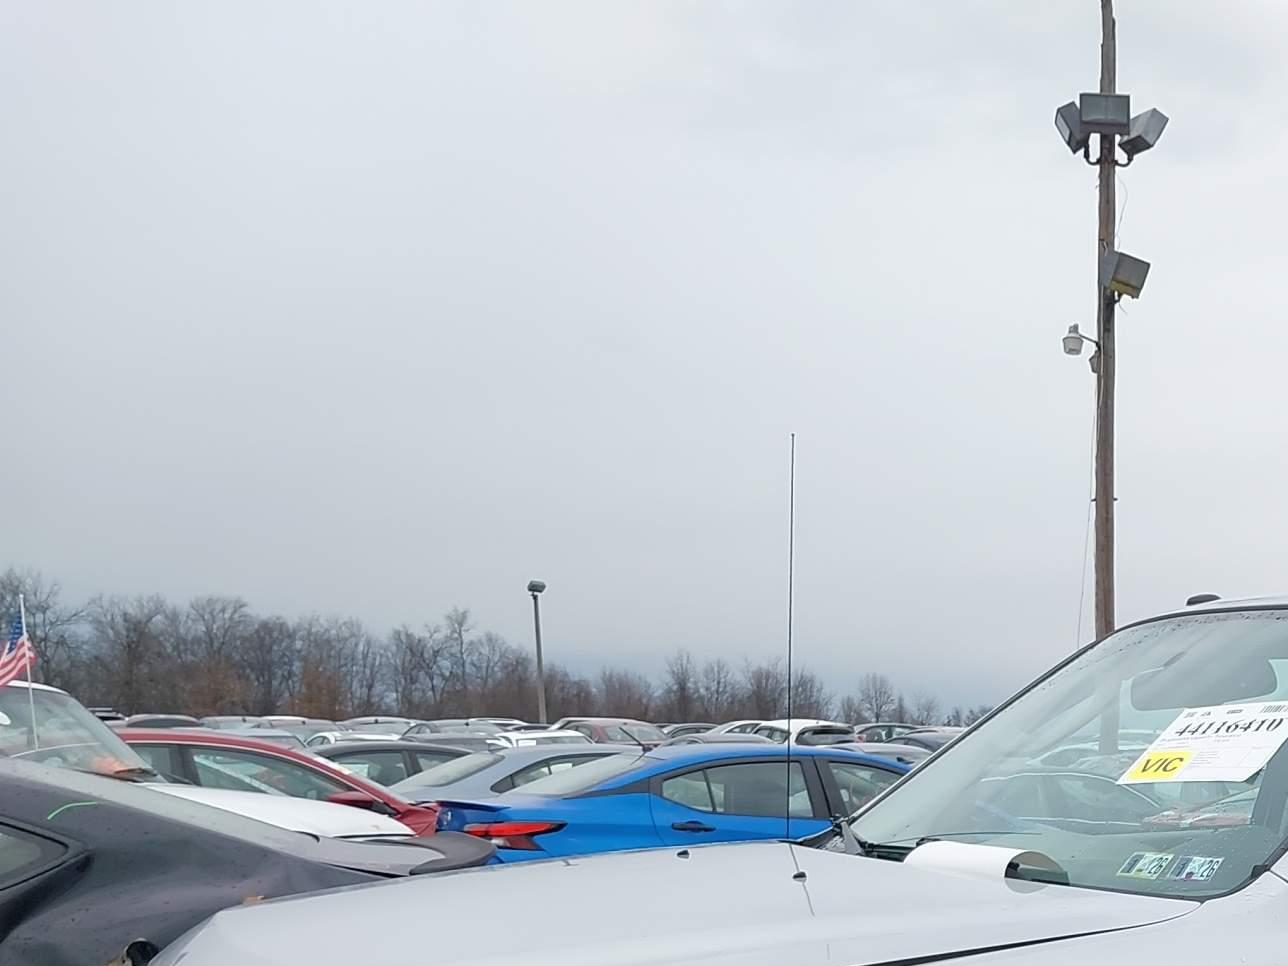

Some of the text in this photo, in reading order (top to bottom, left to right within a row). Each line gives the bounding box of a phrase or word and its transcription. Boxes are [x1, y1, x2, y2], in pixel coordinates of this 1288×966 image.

[1175, 717, 1284, 737] 44116410
[1141, 757, 1184, 773] VIC
[1199, 859, 1220, 878] 26
